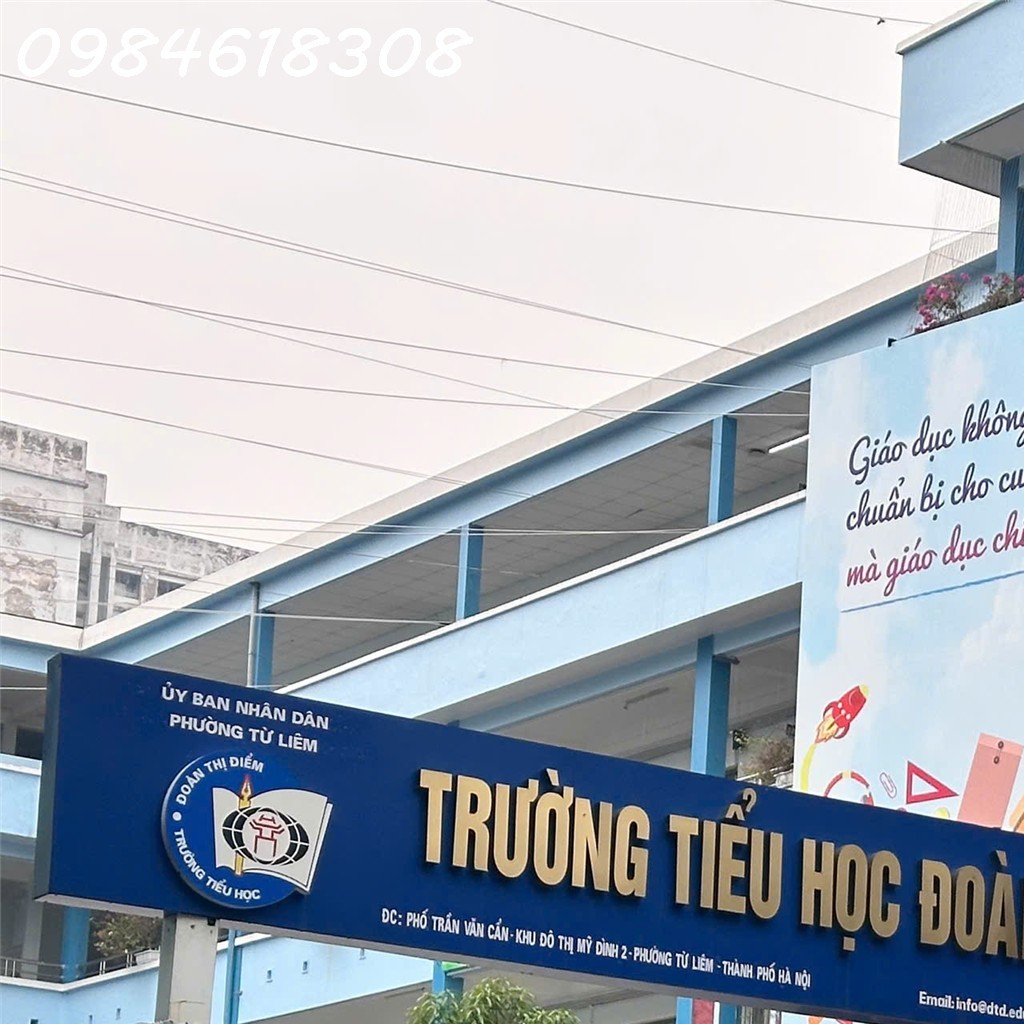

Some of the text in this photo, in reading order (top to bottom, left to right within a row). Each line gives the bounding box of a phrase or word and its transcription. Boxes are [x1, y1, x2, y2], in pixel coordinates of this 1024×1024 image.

[849, 430, 908, 485] Giáo
[912, 415, 955, 462] dục
[846, 476, 915, 530] chuẩn
[919, 473, 945, 521] bị
[950, 462, 994, 506] cho
[846, 547, 882, 587] mà
[883, 538, 938, 597] giáo
[942, 524, 988, 571] dục
[161, 681, 329, 730] ỦY BAN NHÂN DÂN
[170, 714, 318, 752] PHƯỜNG TỪ LIÊM
[176, 753, 264, 805] ĐOÀN THỊ ĐIỂM
[172, 829, 261, 903] TRƯỜNG TIỂU HỌC
[419, 768, 650, 899] TRƯỜNG
[667, 787, 783, 920] TIỂU
[800, 838, 901, 952] HỌC
[381, 907, 402, 926] ĐC:
[406, 908, 429, 930] PHỐ
[432, 912, 460, 935] TRẦN
[464, 917, 484, 938] VĂN
[539, 930, 554, 948] ĐÔ
[558, 935, 574, 955] THỊ
[577, 935, 593, 954] MỸ
[595, 938, 618, 958] ĐÌNH
[675, 952, 689, 969] TỪ
[692, 953, 714, 973] LIÊM
[722, 960, 753, 979] THÀNH
[756, 962, 776, 983] PHỐ
[778, 966, 791, 985] HÀ
[794, 969, 811, 991] NỘI
